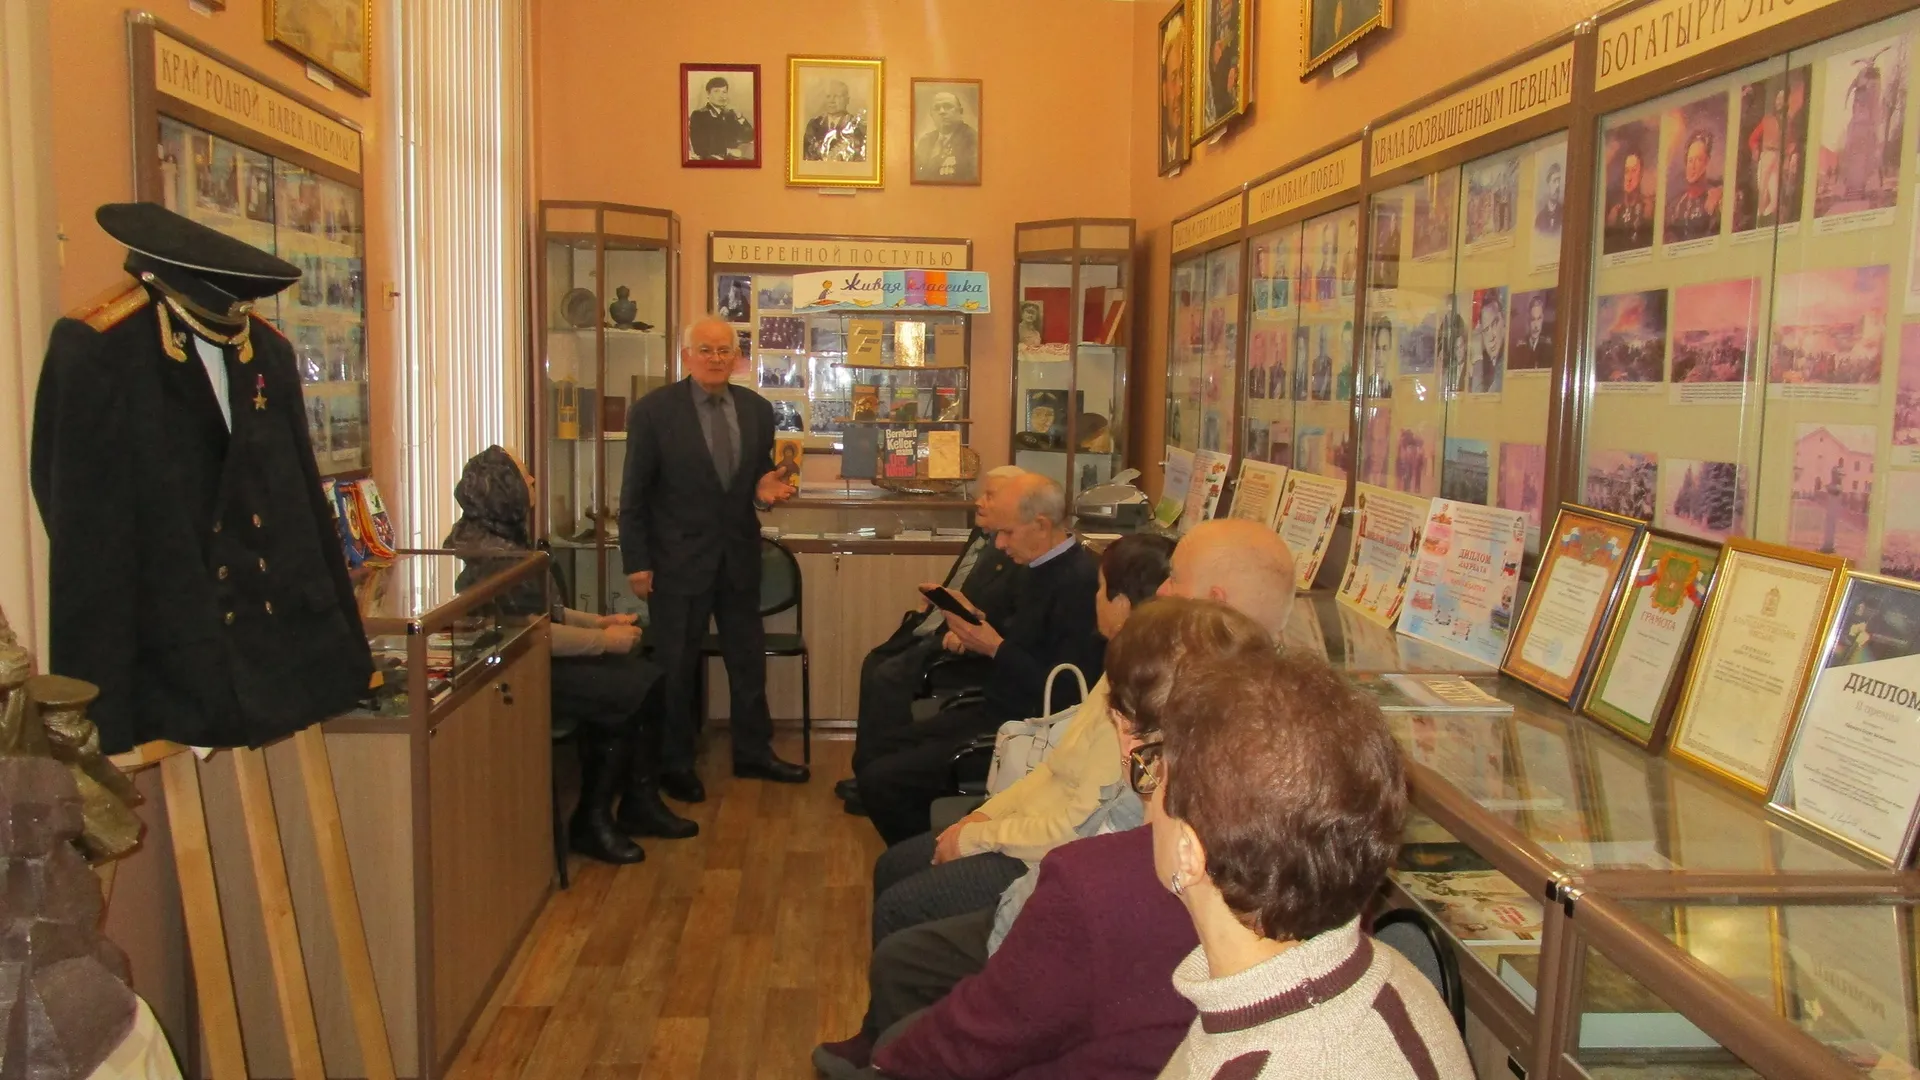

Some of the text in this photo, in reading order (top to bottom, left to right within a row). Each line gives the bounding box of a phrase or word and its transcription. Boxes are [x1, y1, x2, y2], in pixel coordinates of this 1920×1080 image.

[1600, 0, 1726, 77] БОГАТЫРИ
[162, 48, 356, 163] КРАЙ РОДНОЙ, НАВЕК ЛЮБИМЫЙ
[1373, 58, 1571, 167] ХВАЛА ВОЗВЫШЕННЫМ ПЕВЦАМ
[1260, 158, 1347, 213] ОНИ КОВАЛИ ПОБЕДУ
[727, 244, 953, 266] УВЕРЕННОЙ ПОСТУПЬЮ
[840, 272, 983, 294] Живая классика
[885, 428, 917, 438] Bernhard
[1458, 548, 1492, 564] ДИПЛОМ
[1641, 611, 1677, 632] ГРАМОТА
[1843, 672, 1920, 712] ДИПЛОМ
